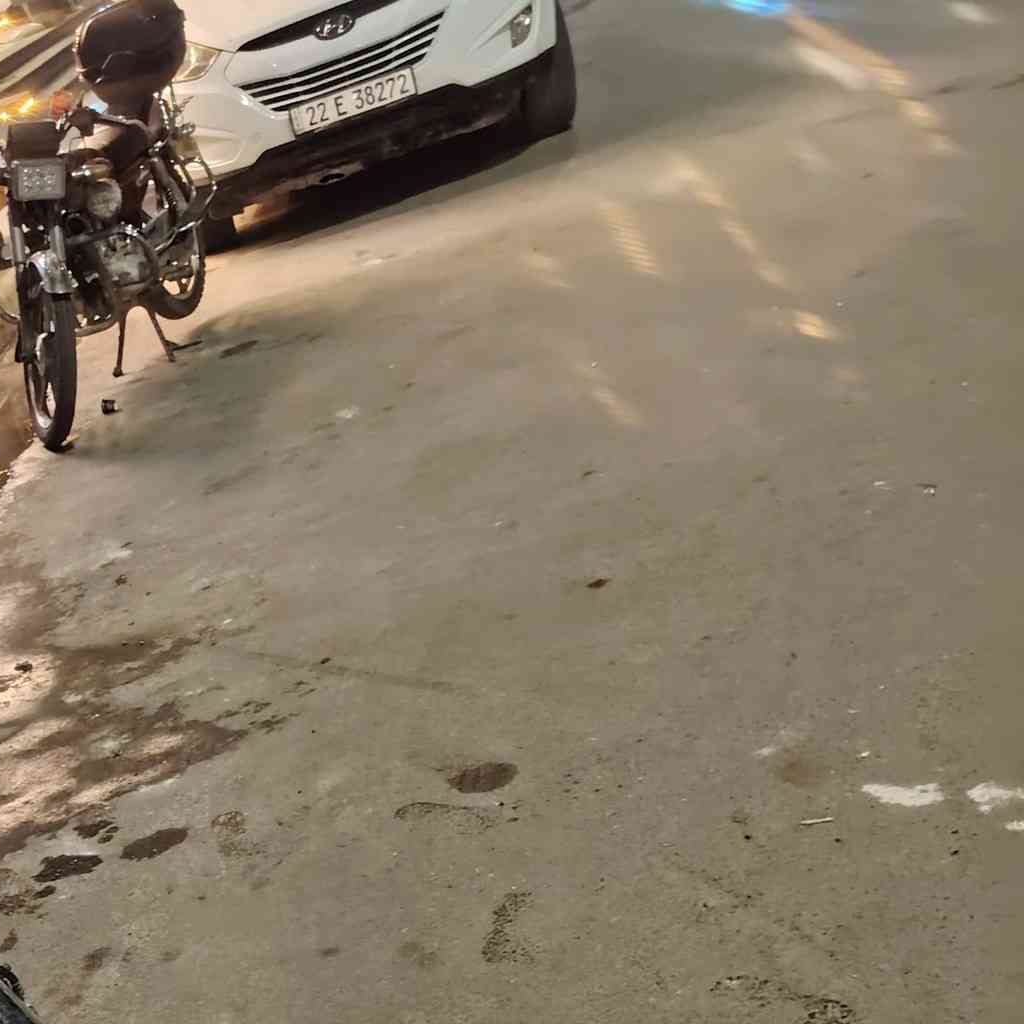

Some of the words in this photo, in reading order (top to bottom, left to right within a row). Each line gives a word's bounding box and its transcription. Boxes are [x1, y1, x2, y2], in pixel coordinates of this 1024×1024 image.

[306, 103, 328, 126] 22
[334, 95, 347, 116] E
[352, 74, 409, 110] 38272
